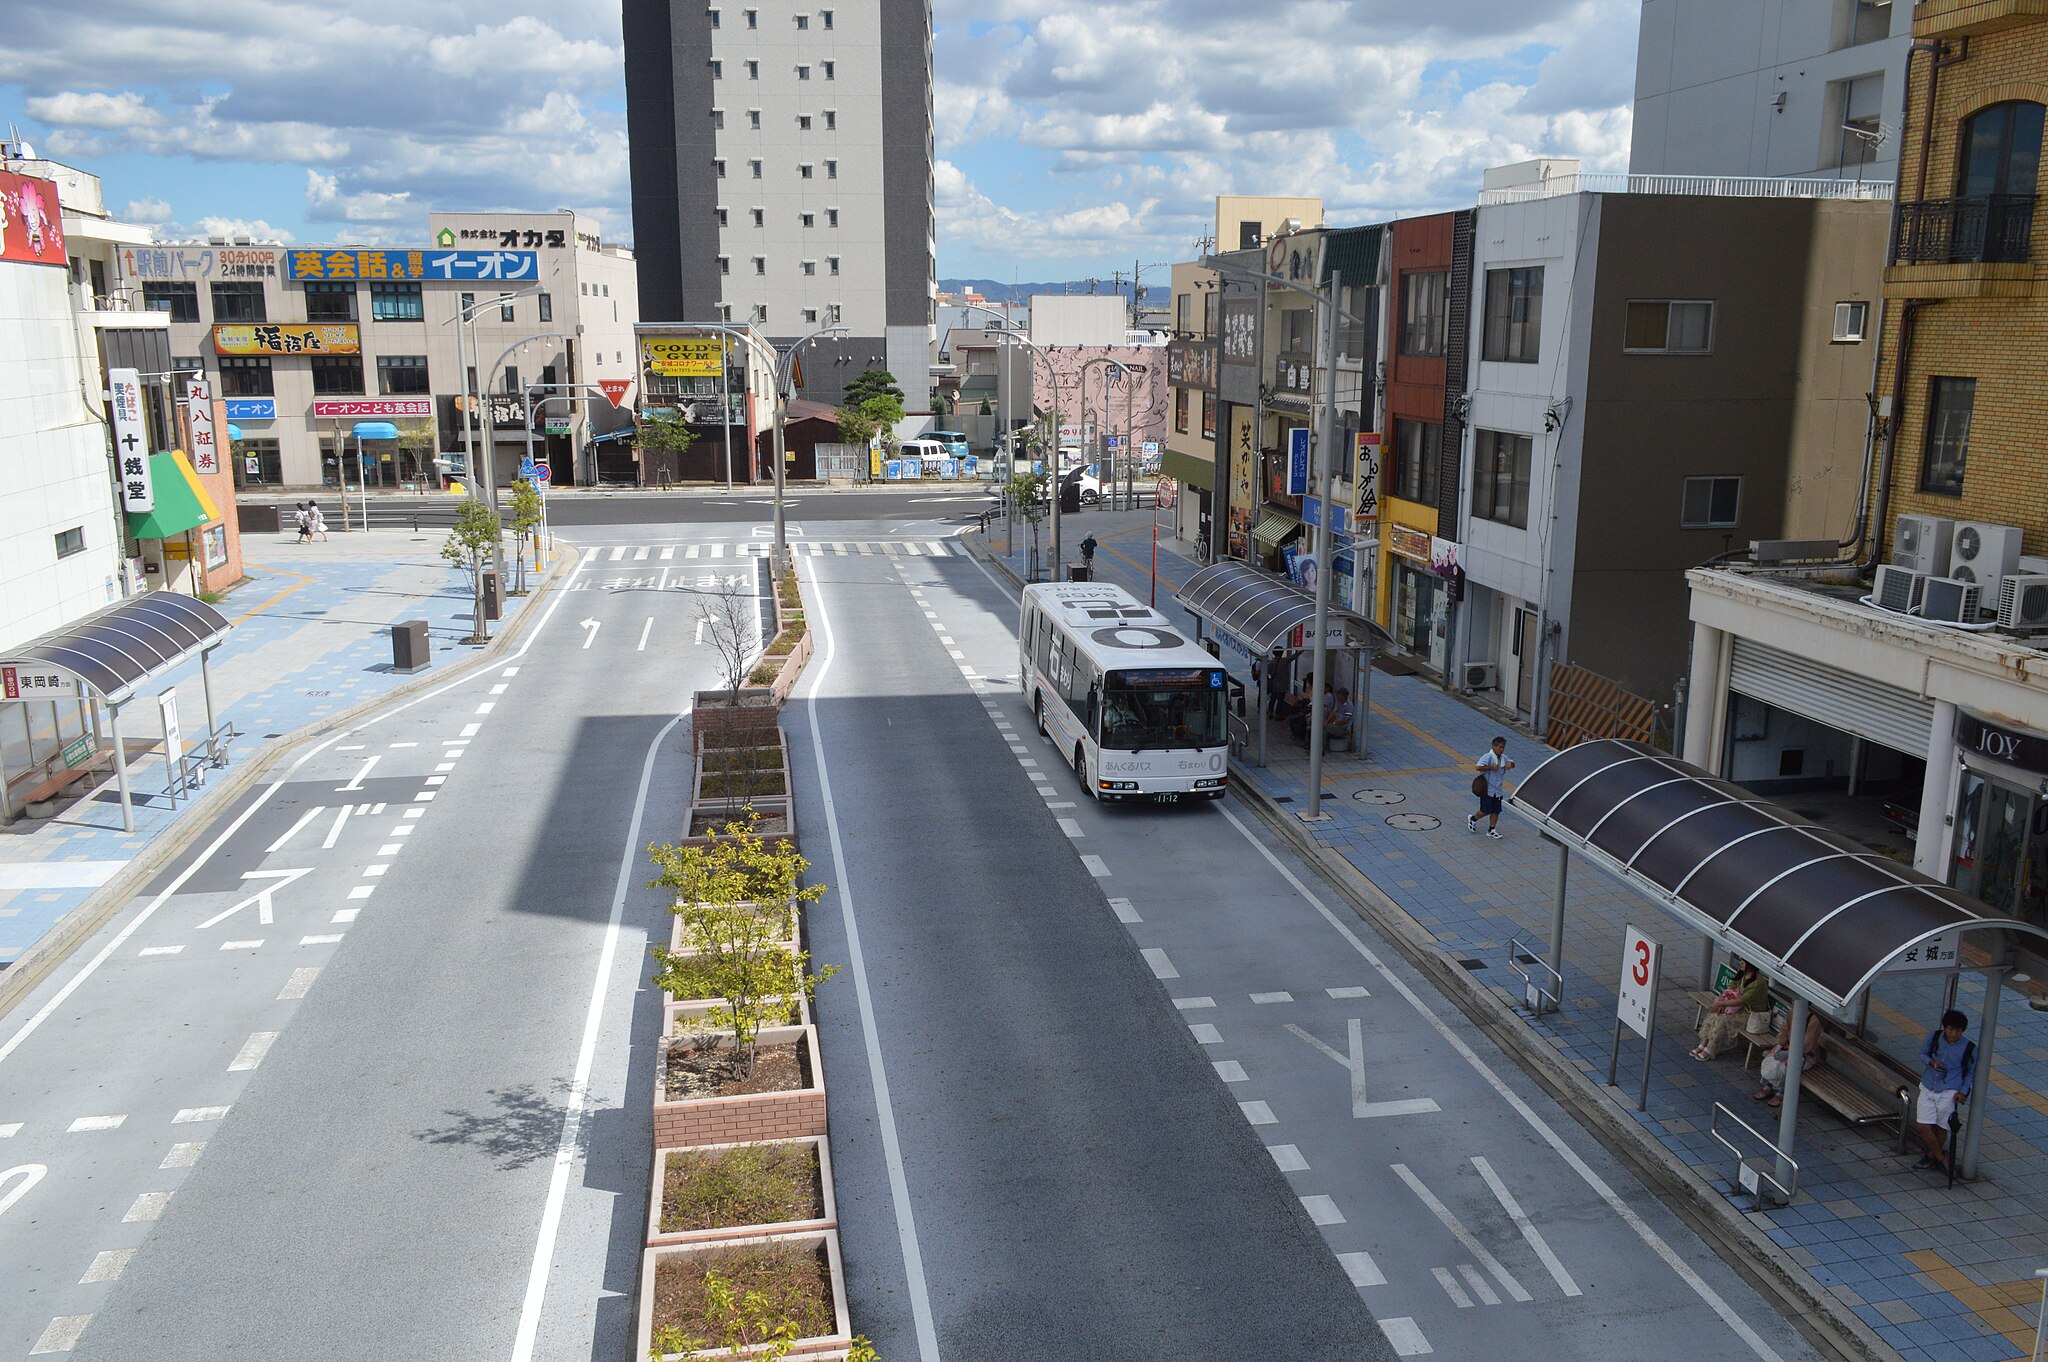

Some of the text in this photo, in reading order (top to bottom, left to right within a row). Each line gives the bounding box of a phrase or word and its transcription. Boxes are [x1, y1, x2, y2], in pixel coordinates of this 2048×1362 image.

[460, 229, 497, 240] 株式会社
[219, 250, 275, 265] 30分100円
[220, 264, 276, 278] 24時間営業
[431, 252, 532, 280] イーオン
[653, 344, 722, 352] GOLD'S
[666, 352, 709, 360] GYM
[605, 385, 626, 394] 止まれ
[317, 400, 430, 415] イーオンこども英会話
[189, 385, 216, 470] 丸八証券
[121, 433, 147, 501] 十銭堂
[569, 574, 657, 592] 止まれ
[667, 572, 752, 589] 止まれ
[20, 674, 60, 689] 東岡崎
[1975, 728, 2022, 761] JOY
[1105, 761, 1152, 772] あんくるバス
[1178, 753, 1222, 772] 右まわり 0
[334, 755, 382, 792] 1
[1632, 940, 1651, 987] 3
